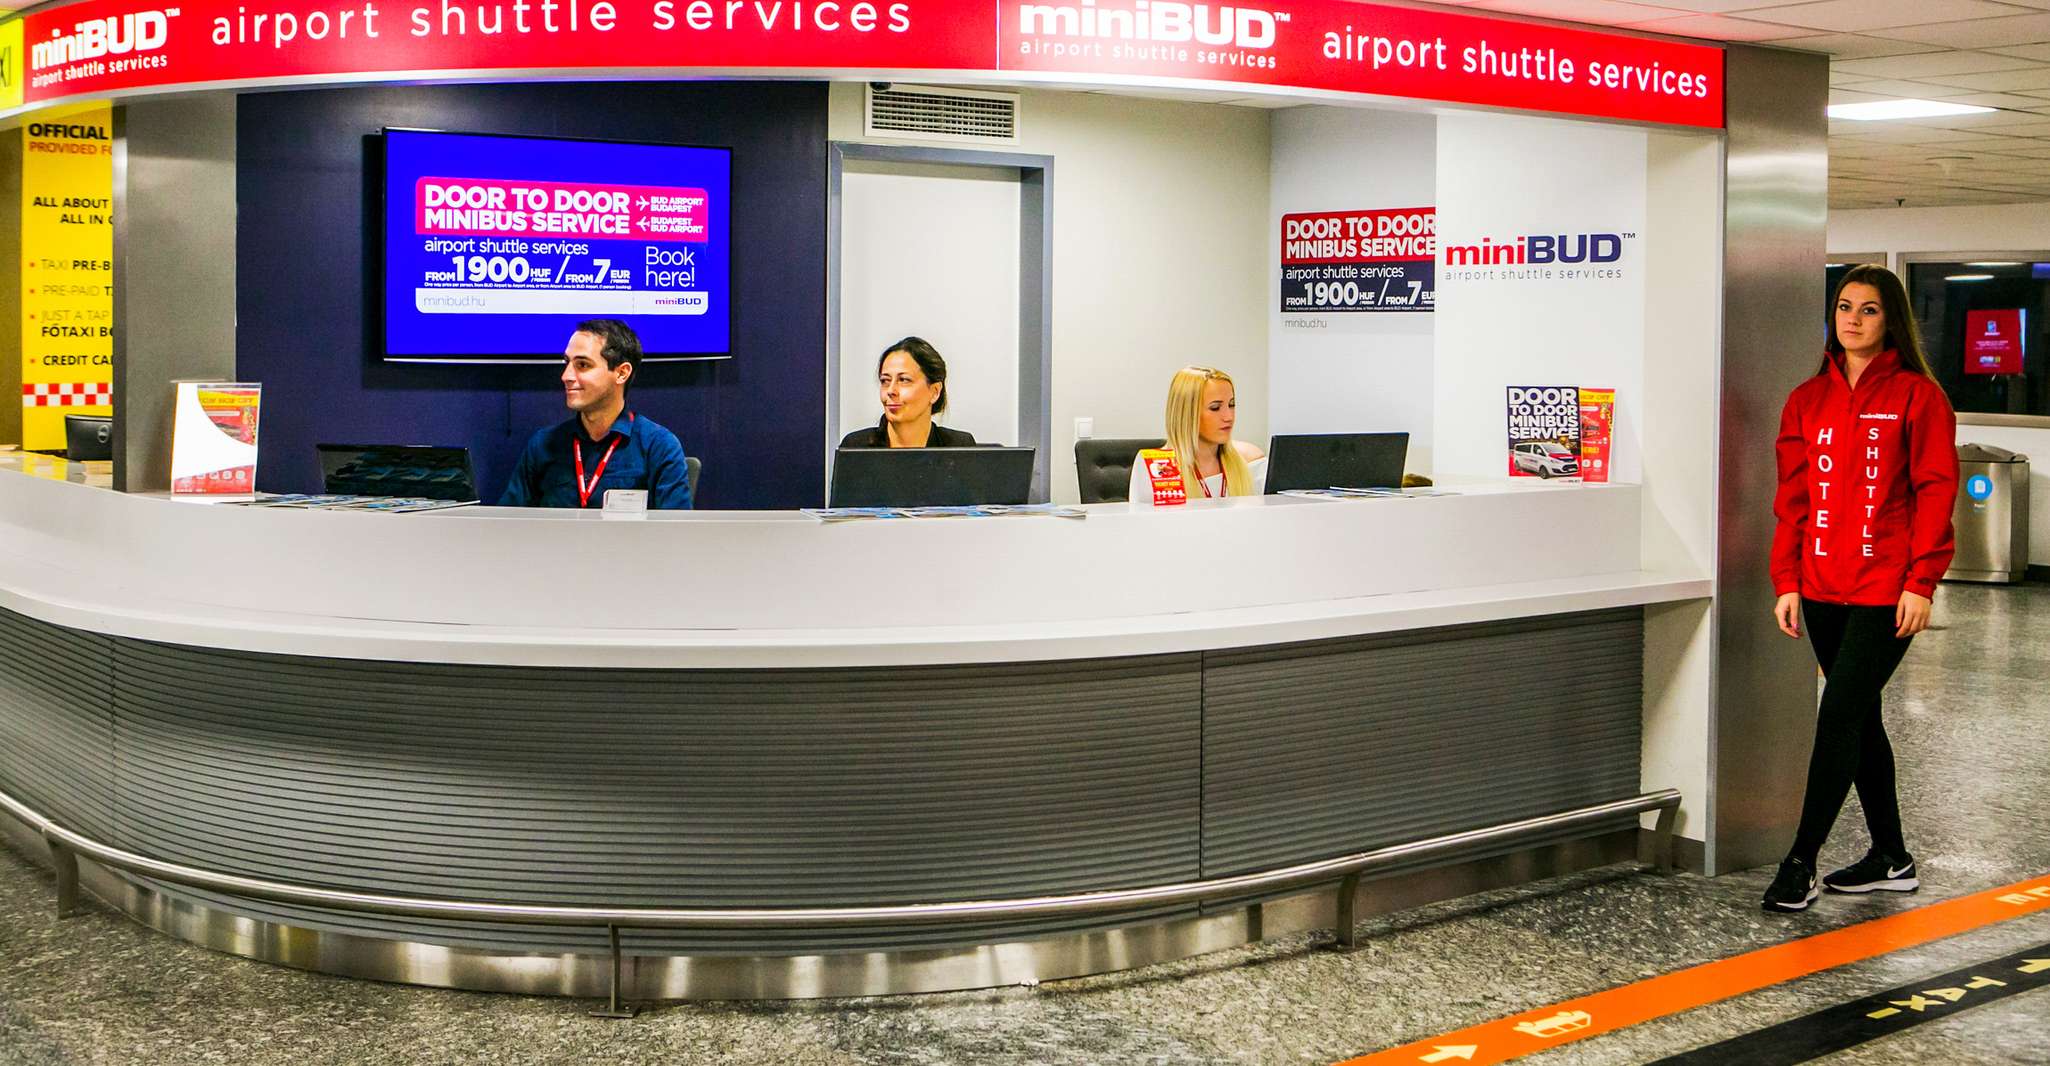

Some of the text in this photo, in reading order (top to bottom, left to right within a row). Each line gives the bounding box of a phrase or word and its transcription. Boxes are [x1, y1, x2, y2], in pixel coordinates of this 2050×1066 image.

[211, 0, 910, 48] airport shuttle services
[1020, 39, 1276, 69] airport shuttle services
[1323, 25, 1708, 98] airport shuttle services
[32, 54, 167, 88] airport shuttle services
[28, 123, 109, 140] OFFICIAL
[29, 142, 97, 154] PROVIDED
[33, 197, 109, 208] ALL ABOUT
[425, 184, 630, 213] DOOR TO DOOR
[651, 196, 704, 206] BUD AIRPORT
[651, 204, 692, 213] BUDAPEST
[60, 213, 85, 224] ALL
[89, 215, 103, 224] IN
[425, 208, 630, 234] MINIBUS SERVICE
[651, 217, 692, 225] BUDAPEST
[1286, 214, 1436, 240] DOOR TO DOOR
[424, 237, 589, 255] airport shuttle services
[1286, 236, 1436, 259] MINIBUS SERVICE
[41, 259, 69, 270] TAXI
[646, 246, 695, 266] Book
[425, 272, 455, 281] FROM
[452, 256, 530, 282] 1900
[530, 269, 551, 278] HUF
[566, 274, 593, 283] FROM
[593, 259, 611, 284] 7
[610, 270, 630, 279] EUR
[646, 265, 695, 287] here!
[1286, 264, 1404, 281] airport shuttle services
[1445, 267, 1622, 281] airport shuttle services
[104, 286, 112, 296] T
[1286, 297, 1306, 305] FROM
[1304, 282, 1359, 306] 1900
[1359, 291, 1375, 300] HUF
[1385, 296, 1408, 305] FROM
[1407, 281, 1422, 305] 7
[424, 295, 485, 307] minibud.hu
[655, 297, 702, 305] miniBUD
[40, 310, 110, 323] JUST A TAP
[1285, 318, 1327, 329] minibud.hu
[43, 355, 88, 365] CREDIT
[1508, 388, 1577, 405] DOOR
[1509, 405, 1531, 415] TO
[1533, 405, 1578, 415] DOOR
[1509, 415, 1578, 427] MINIBUS
[1509, 427, 1579, 439] SERVICE
[1815, 427, 1833, 556] HOTEL
[1862, 427, 1879, 557] SHUTTLE
[1866, 975, 2008, 1020] TAXI
